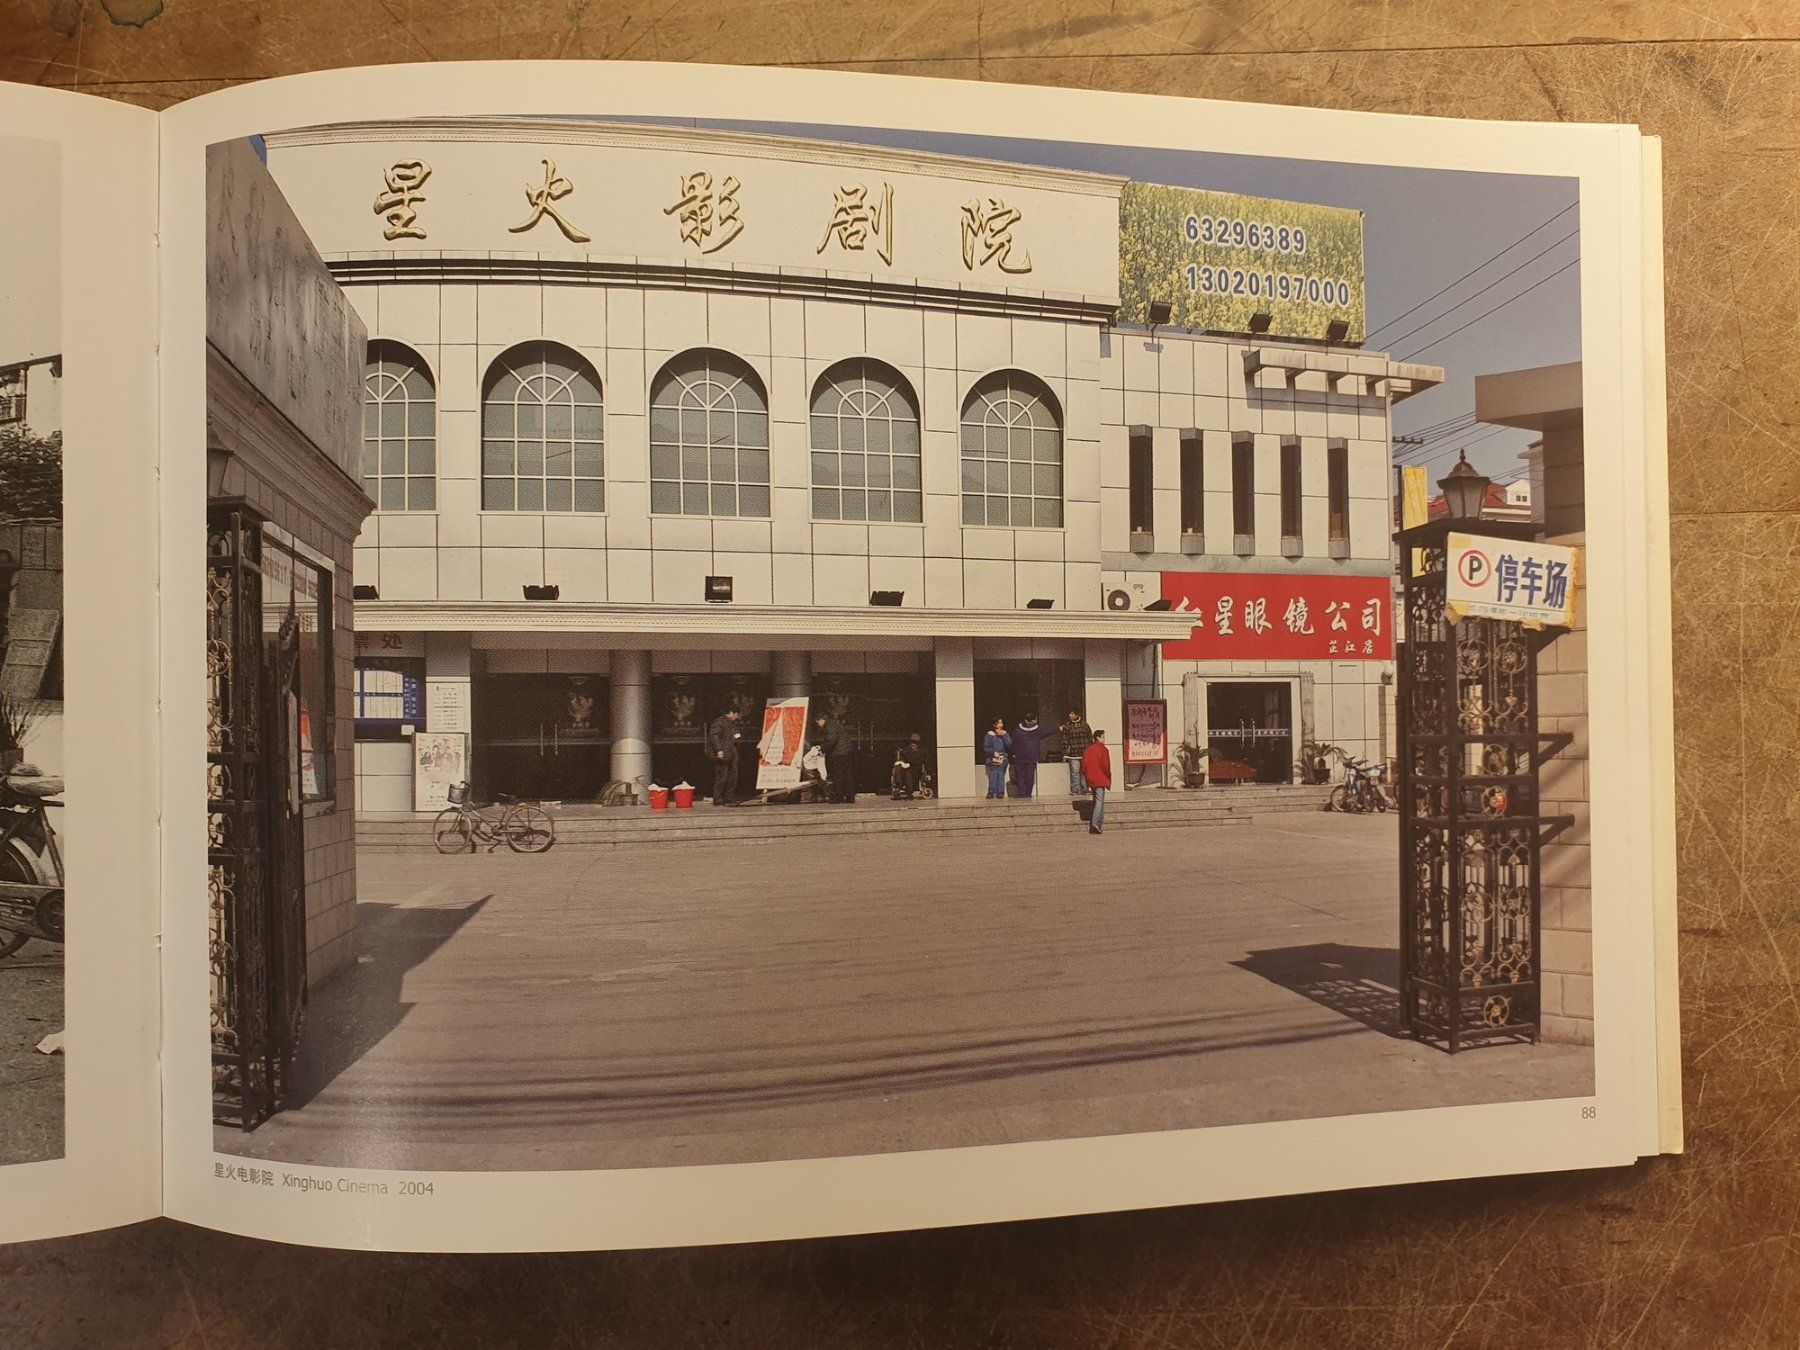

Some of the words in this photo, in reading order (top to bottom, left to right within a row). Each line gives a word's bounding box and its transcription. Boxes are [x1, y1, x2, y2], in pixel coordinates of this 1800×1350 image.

[374, 158, 1032, 274] 星火影剧院
[1186, 215, 1305, 253] 63296389
[1186, 266, 1349, 306] 13020197000
[1468, 555, 1483, 580] P
[1494, 553, 1568, 609] 停车场
[1581, 1106, 1597, 1119] 88
[214, 1162, 274, 1187] 星火电影院
[282, 1173, 333, 1192] Xinghuo
[337, 1178, 389, 1195] Cinema
[398, 1181, 435, 1196] 2004
